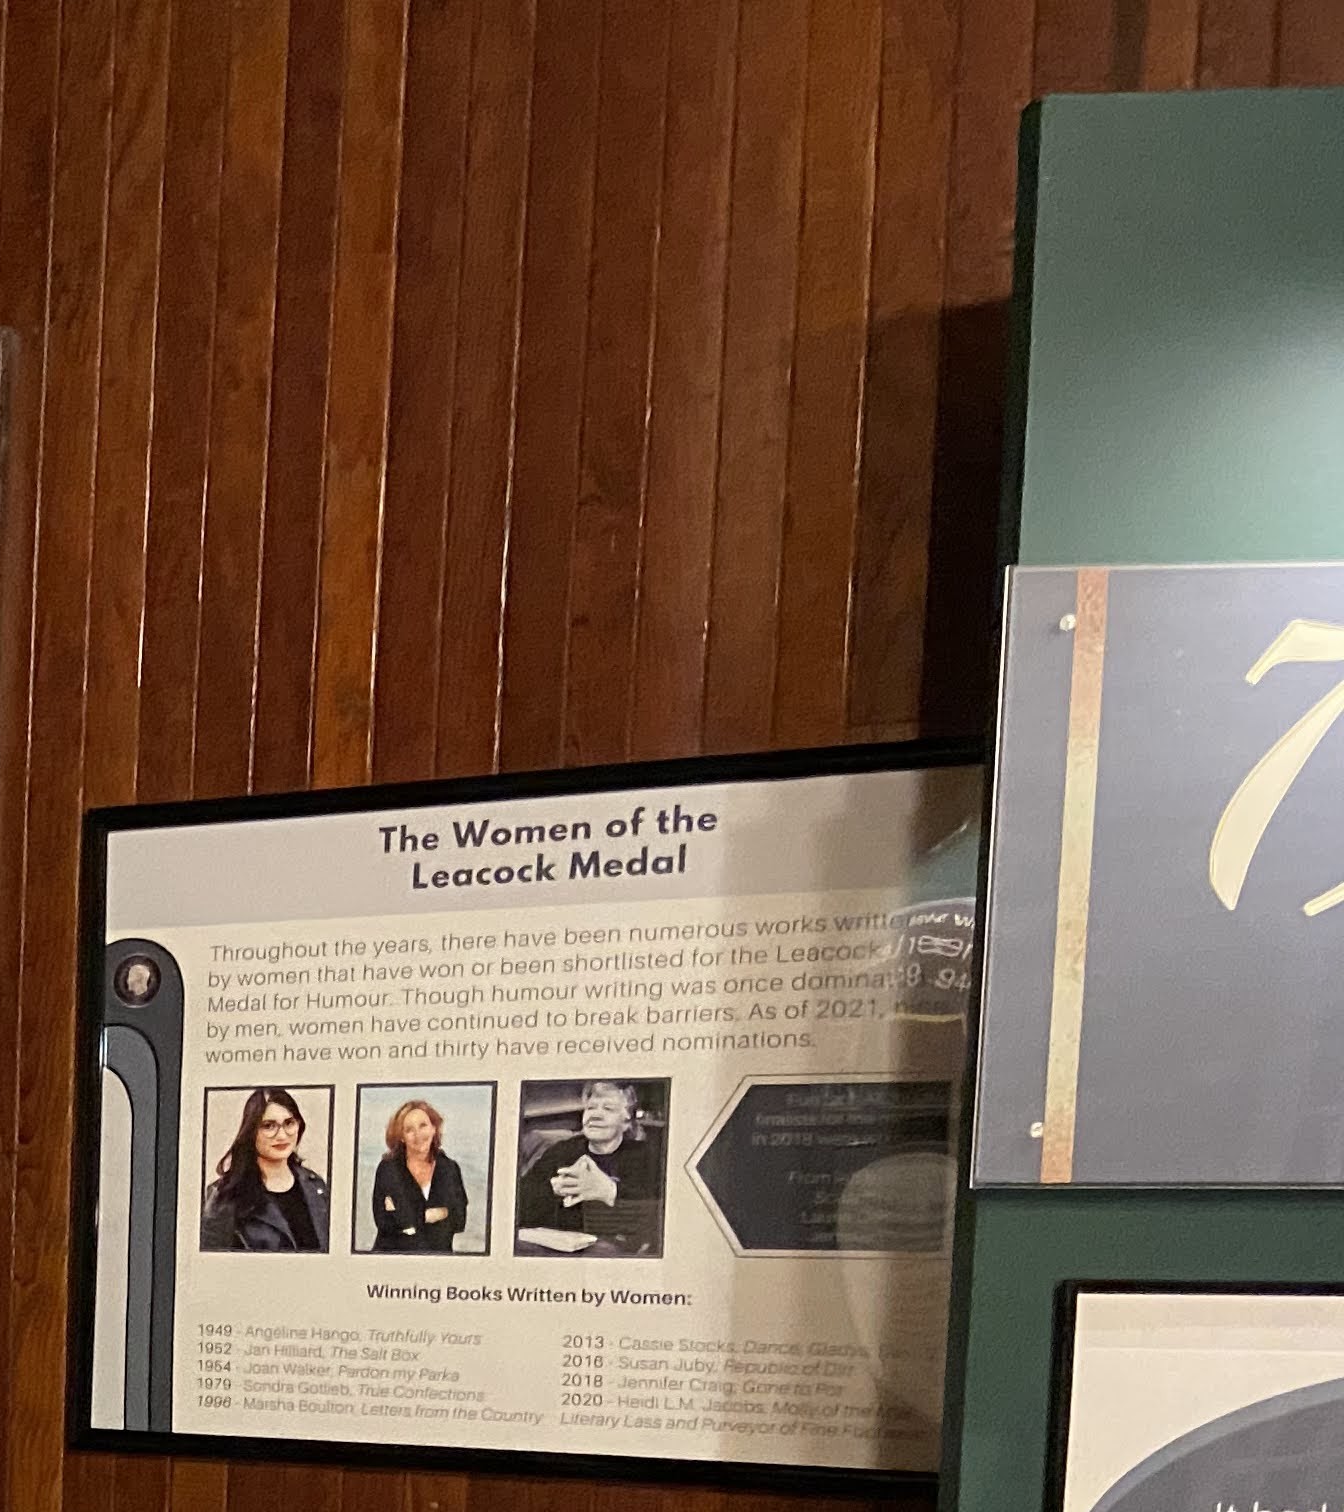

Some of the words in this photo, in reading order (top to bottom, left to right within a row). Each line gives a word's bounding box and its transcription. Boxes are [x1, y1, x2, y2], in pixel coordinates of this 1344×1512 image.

[1209, 619, 1344, 917] 7
[379, 826, 439, 854] The
[453, 820, 592, 848] Women
[606, 806, 646, 838] of
[657, 804, 718, 835] the
[412, 854, 555, 889] Leacock
[569, 844, 687, 879] Medal
[211, 942, 327, 964] Throughout
[334, 939, 367, 956] the
[373, 939, 432, 959] years,
[442, 933, 496, 951] there
[504, 931, 556, 947] have
[564, 928, 621, 945] been
[629, 922, 747, 941] numerous
[755, 916, 827, 935] works
[208, 971, 231, 991] by
[237, 970, 310, 986] women
[318, 965, 355, 983] that
[362, 964, 413, 981] have
[419, 963, 464, 978] won
[471, 962, 493, 976] or
[500, 957, 555, 975] been
[563, 950, 684, 972] shortlisted
[692, 948, 723, 967] for
[731, 947, 768, 965] the
[776, 941, 883, 963] Leacock
[208, 994, 267, 1012] Medal
[273, 993, 299, 1010] for
[402, 986, 484, 1008] Though
[492, 985, 577, 1002] humour
[585, 981, 663, 1001] writing
[671, 980, 716, 996] was
[723, 977, 783, 994] once
[207, 1024, 230, 1042] by
[289, 1020, 363, 1035] women
[371, 1016, 421, 1033] have
[427, 1011, 539, 1031] continued
[546, 1012, 567, 1027] to
[575, 1008, 638, 1026] break
[748, 1004, 777, 1020] As
[784, 1003, 807, 1019] of
[205, 1049, 277, 1063] women
[283, 1045, 331, 1061] have
[338, 1045, 381, 1060] won
[388, 1040, 427, 1059] and
[435, 1040, 489, 1060] thirty
[496, 1039, 549, 1055] have
[557, 1035, 654, 1054] received
[662, 1033, 815, 1051] nominations.
[367, 1284, 441, 1303] Winning
[446, 1286, 503, 1301] Books
[507, 1288, 576, 1302] Written
[581, 1288, 605, 1307] by
[610, 1290, 694, 1307] Women:
[198, 1324, 233, 1338] 1949
[562, 1334, 605, 1350] 2013
[561, 1393, 604, 1408] 2020
